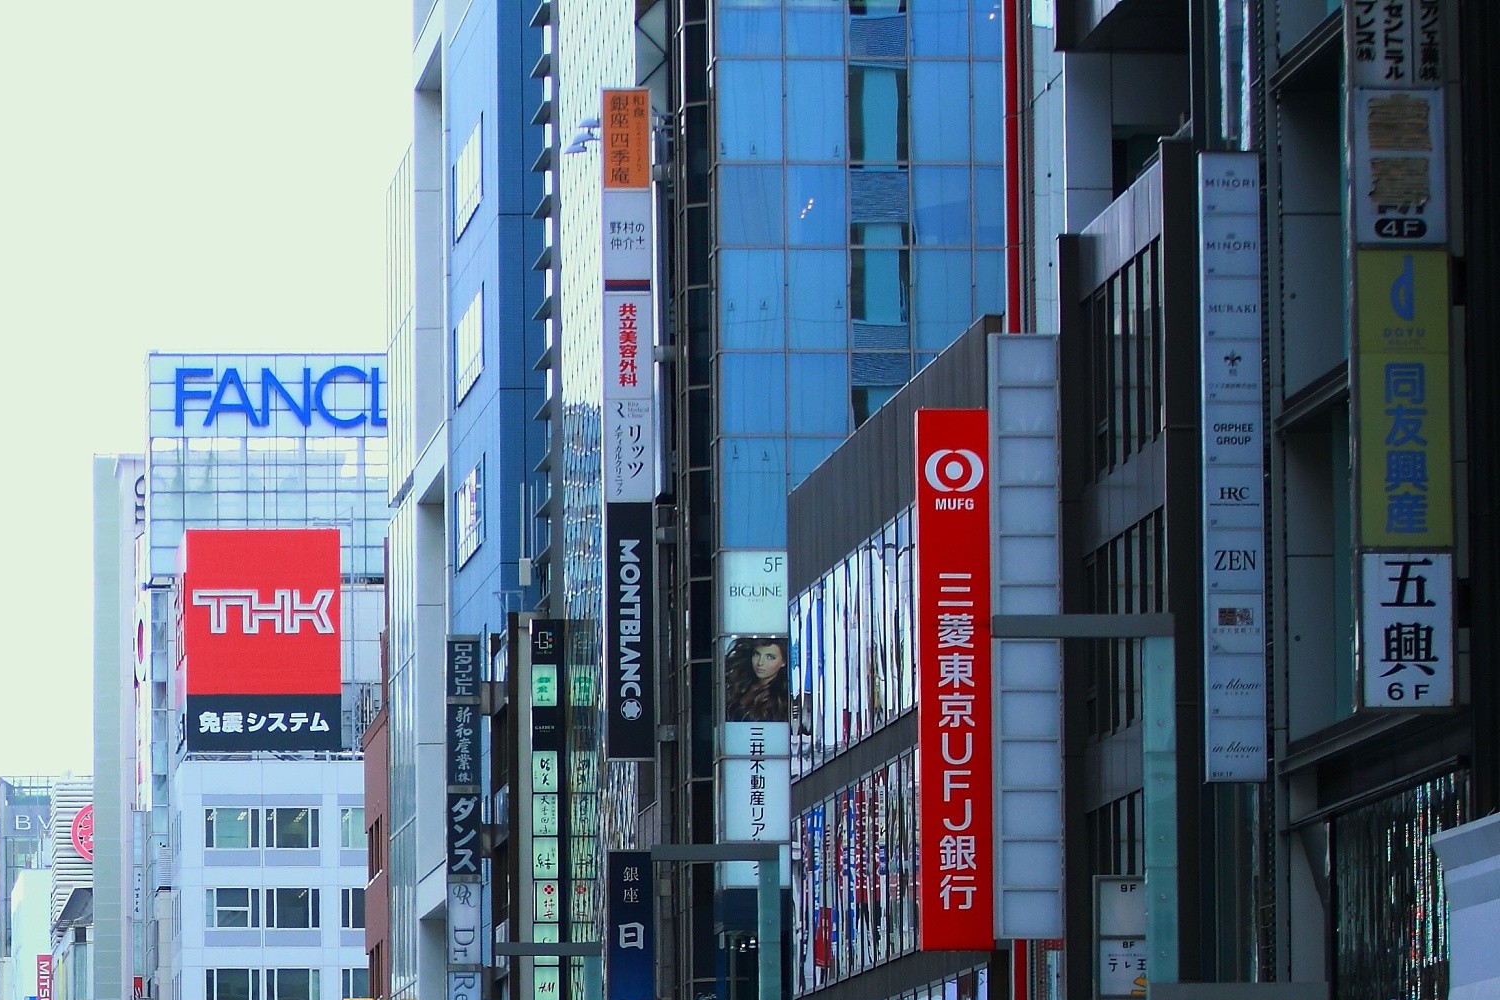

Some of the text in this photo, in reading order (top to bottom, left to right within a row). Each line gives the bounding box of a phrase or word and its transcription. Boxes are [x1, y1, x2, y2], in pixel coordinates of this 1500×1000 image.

[1206, 178, 1255, 188] MINORI
[609, 222, 646, 234] 野村の
[1381, 221, 1420, 237] 4F
[1206, 241, 1256, 250] MINORI
[1208, 304, 1257, 313] MURAKI
[618, 303, 638, 387] 共立美容外科
[1213, 423, 1254, 432] ORPHEE
[1216, 435, 1251, 445] GROUP
[1385, 362, 1429, 535] 同友興産
[627, 424, 644, 480] リッツ
[1219, 487, 1250, 500] HRC
[935, 498, 975, 510] MUFG
[763, 557, 783, 574] 5F
[1213, 550, 1257, 571] ZEN
[729, 585, 783, 597] BIGUINE
[192, 588, 336, 634] THK
[619, 538, 642, 698] MONTBLANC
[1379, 557, 1439, 678] 五興
[1386, 683, 1430, 701] 6F
[198, 711, 330, 734] 免震システム
[936, 572, 978, 912] 三菱東京UFJ銀行
[450, 796, 478, 874] ダンス
[622, 866, 640, 904] 銀座
